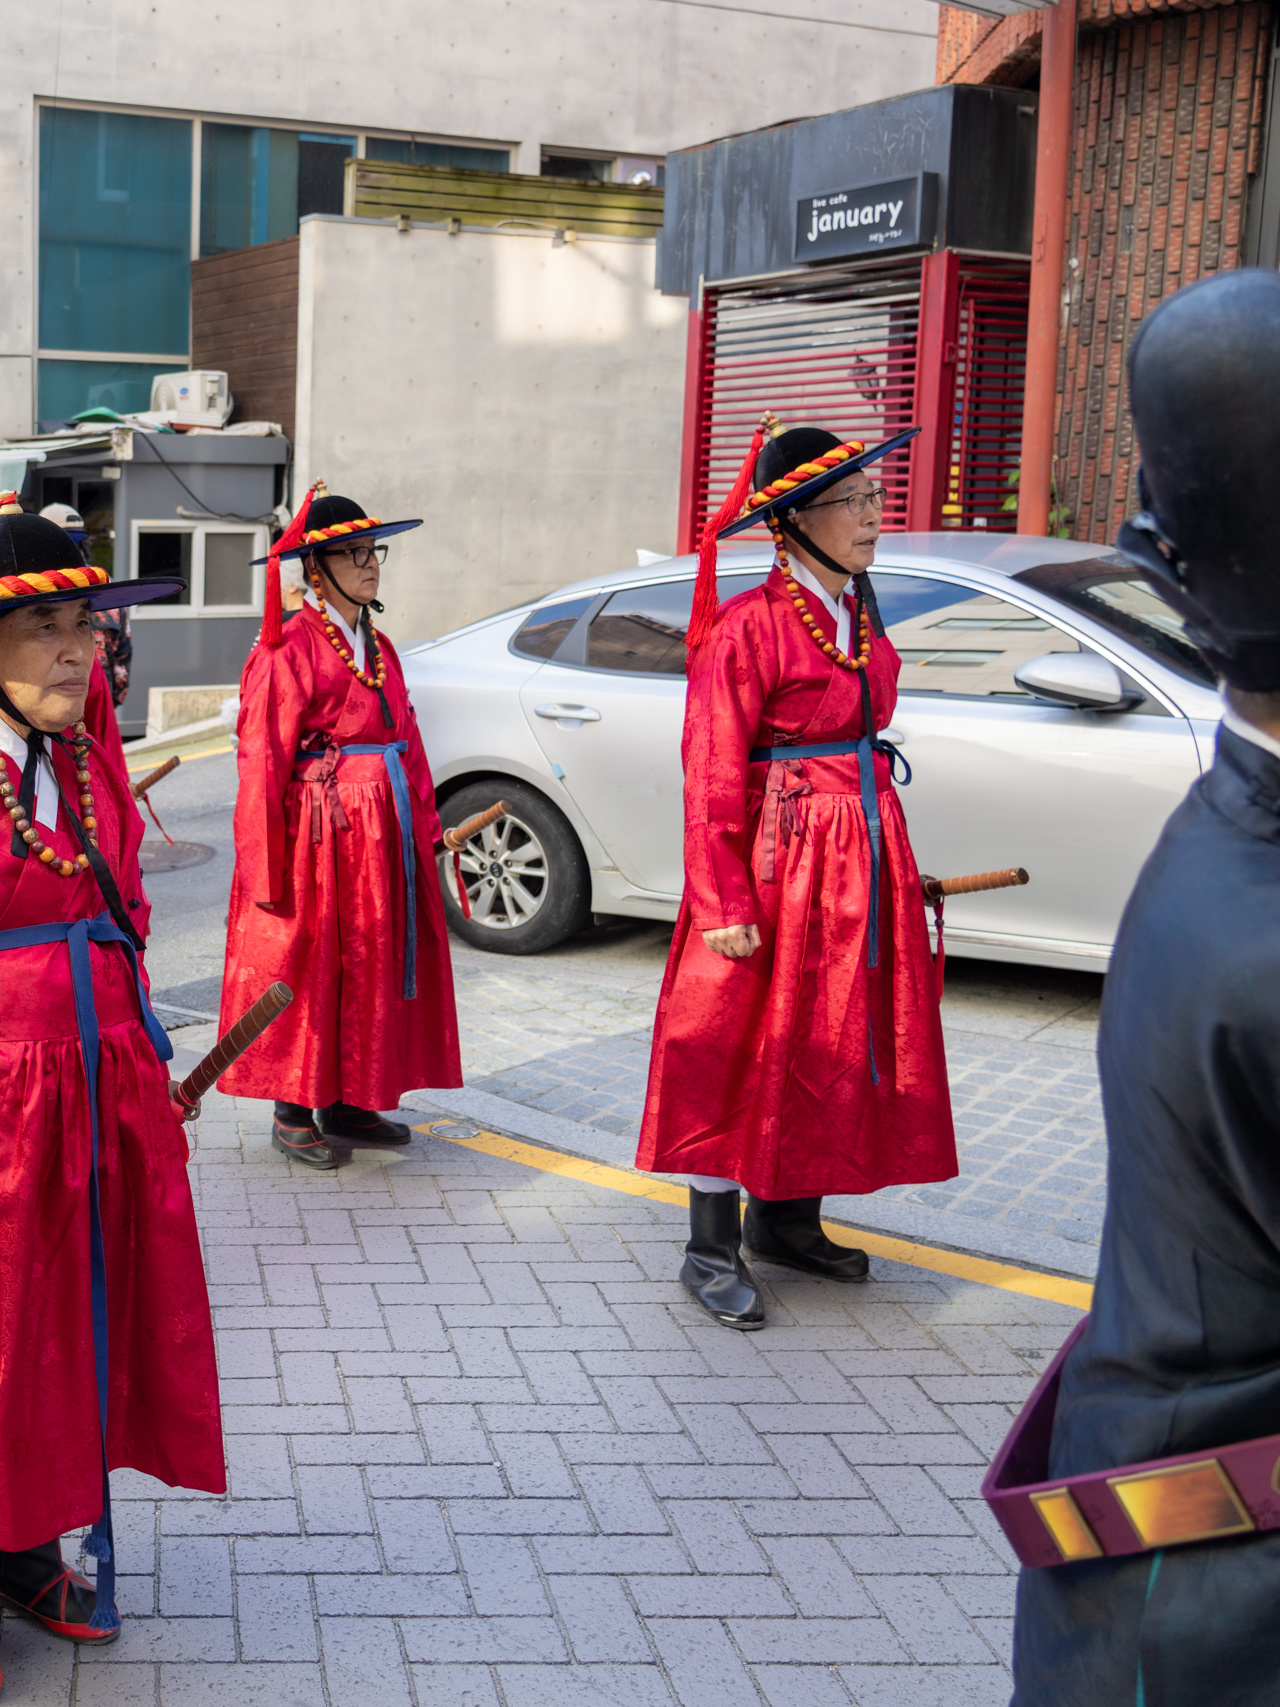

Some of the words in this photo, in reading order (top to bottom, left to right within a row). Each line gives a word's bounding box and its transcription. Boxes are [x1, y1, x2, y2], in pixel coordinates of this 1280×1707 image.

[812, 198, 826, 208] live
[829, 193, 848, 206] cafe
[807, 200, 903, 242] january
